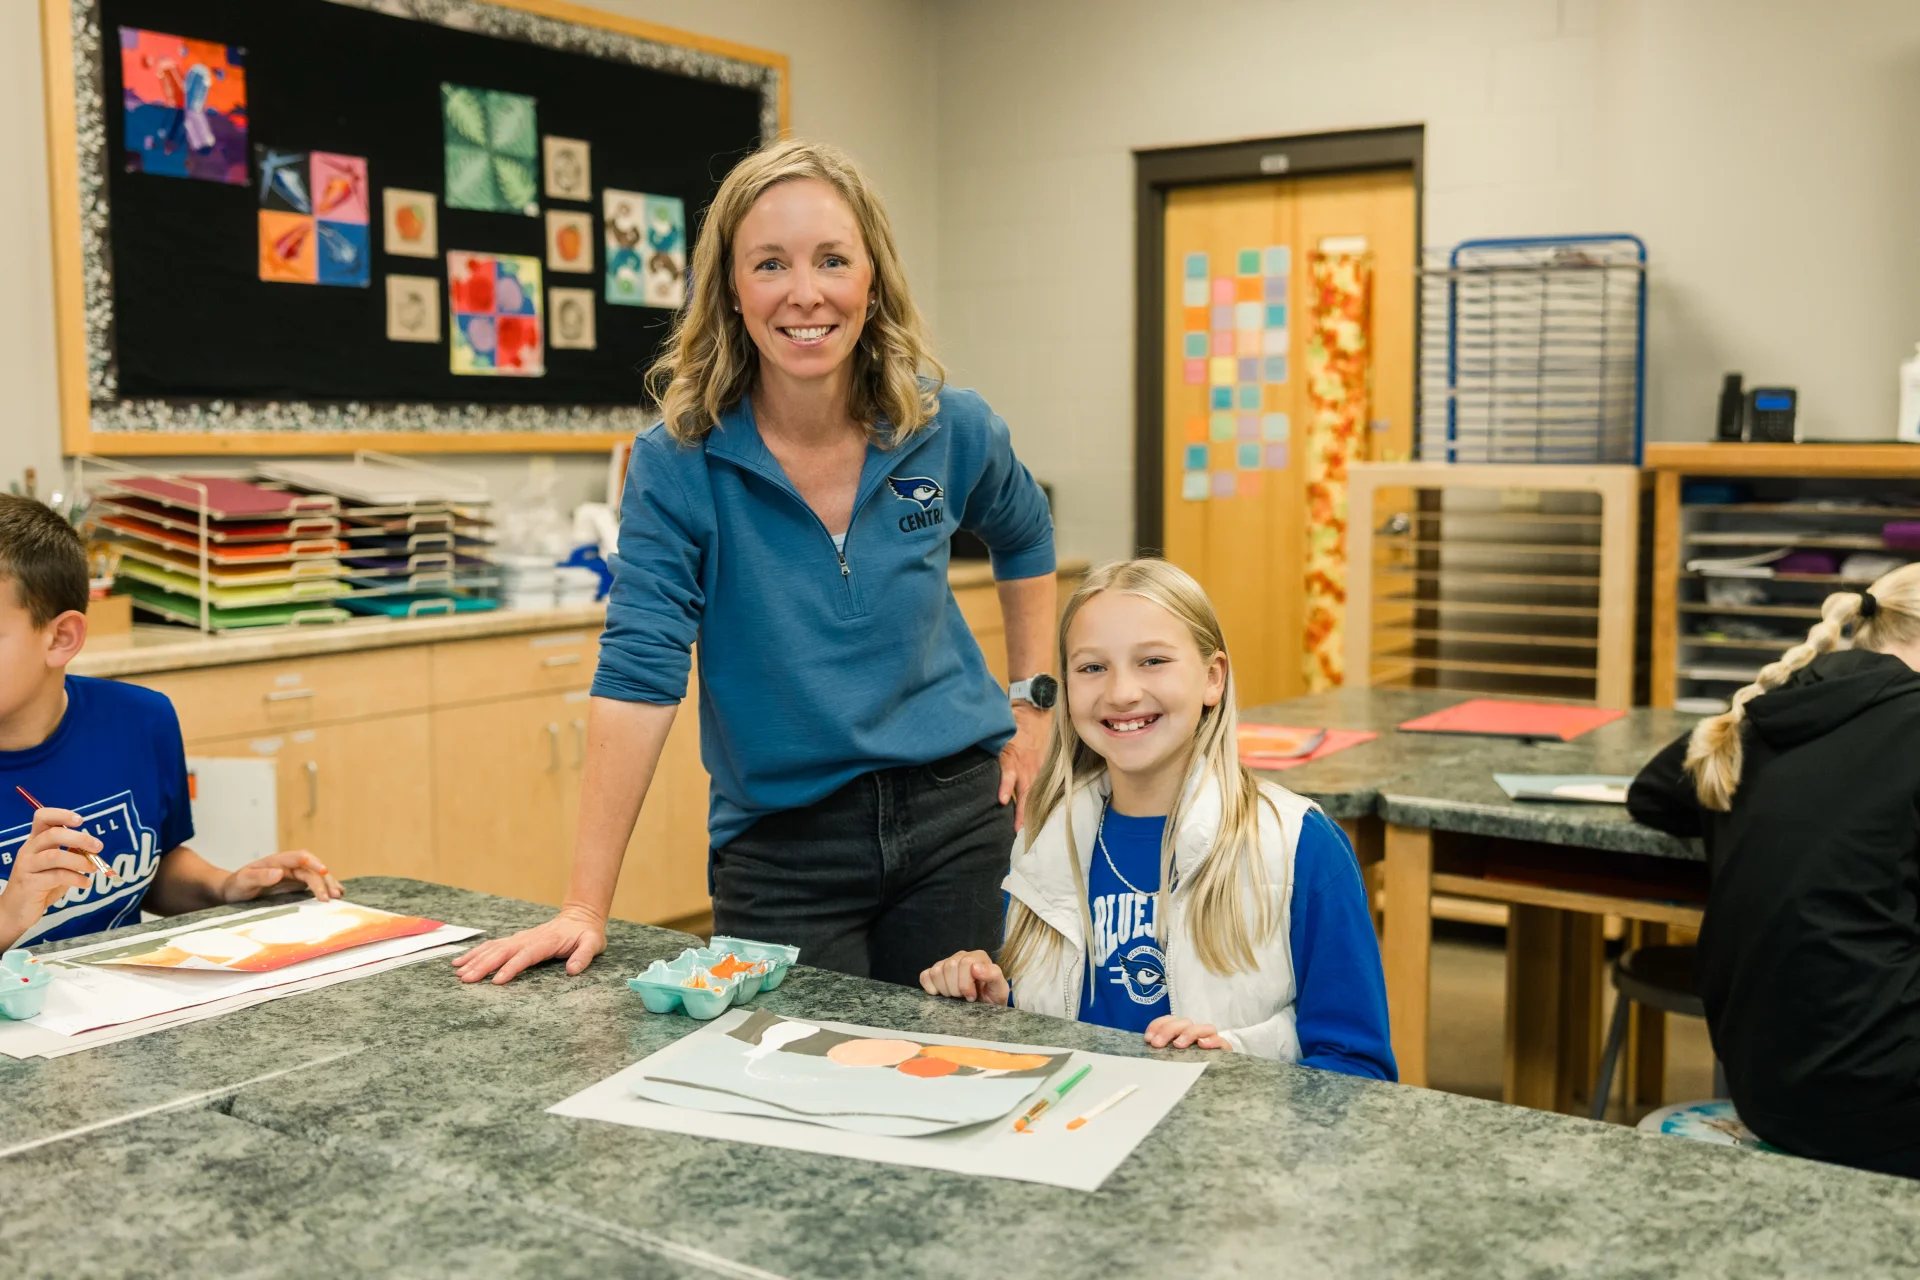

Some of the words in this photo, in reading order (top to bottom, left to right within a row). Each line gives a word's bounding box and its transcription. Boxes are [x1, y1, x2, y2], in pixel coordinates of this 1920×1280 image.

[1093, 893, 1160, 967] BLUEJ
[1149, 948, 1166, 967] MINNES
[1143, 991, 1165, 1004] SCHOOL
